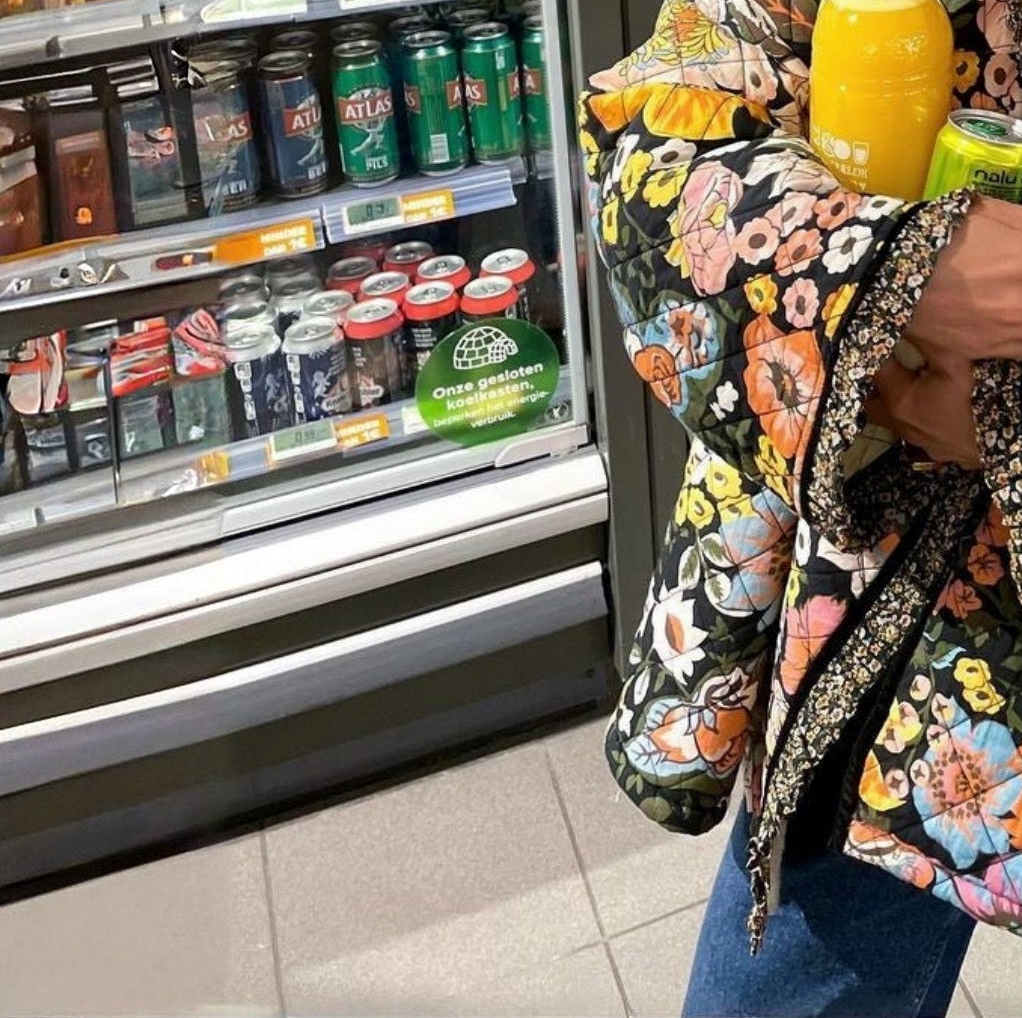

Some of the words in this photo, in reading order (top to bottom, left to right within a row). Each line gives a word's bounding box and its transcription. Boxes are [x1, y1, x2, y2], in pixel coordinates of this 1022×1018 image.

[346, 95, 392, 119] ATLAS
[974, 169, 1017, 184] nalu
[432, 381, 474, 399] Onze
[477, 362, 544, 390] gesloten
